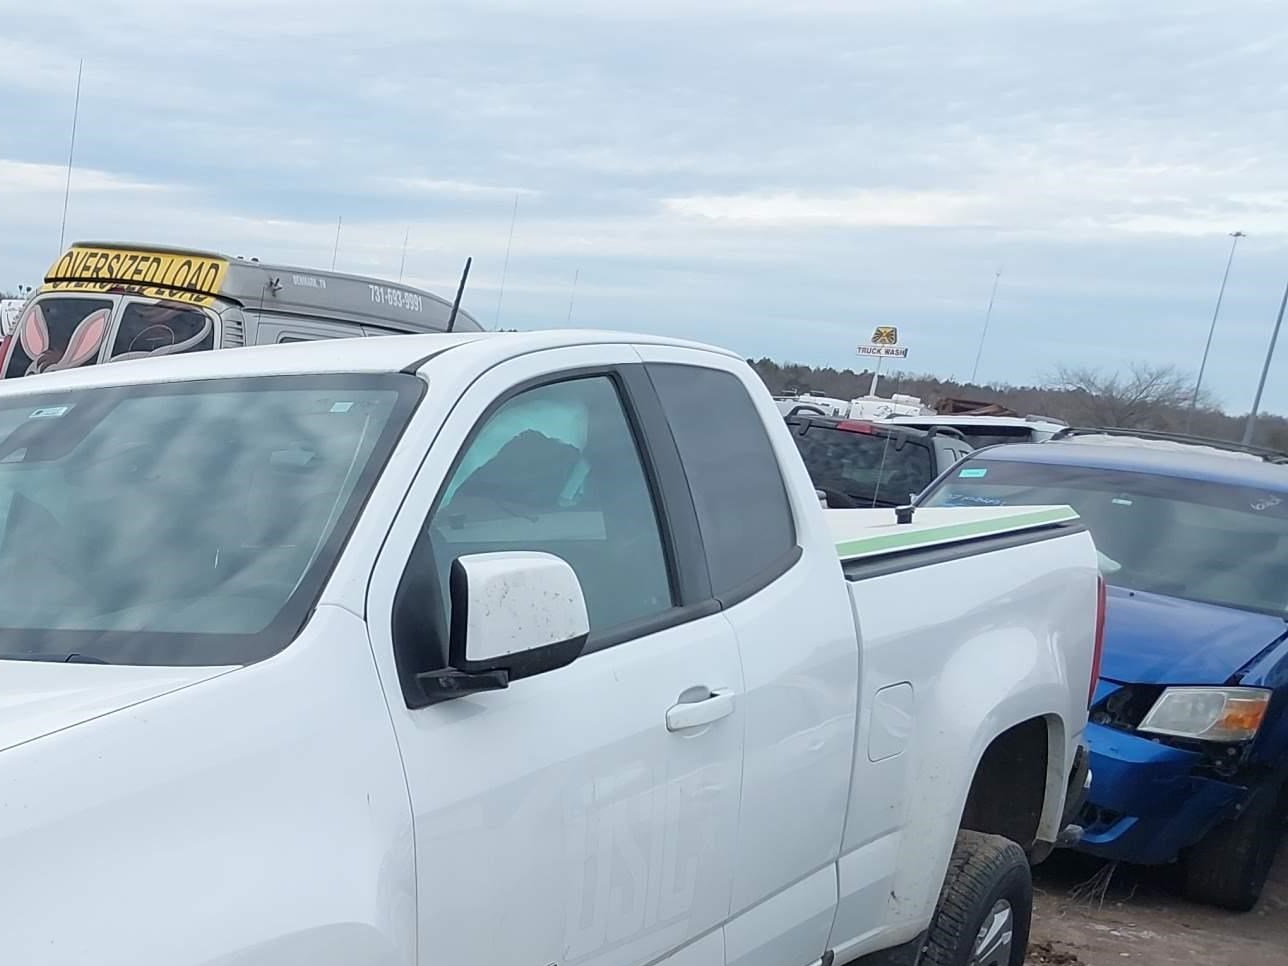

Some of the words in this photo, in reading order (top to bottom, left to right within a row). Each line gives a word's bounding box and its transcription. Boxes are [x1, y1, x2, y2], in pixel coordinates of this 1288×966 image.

[51, 250, 162, 292] OVERSIZED
[157, 258, 221, 303] LOAD
[857, 346, 882, 356] TRUCK
[884, 348, 905, 356] WASH
